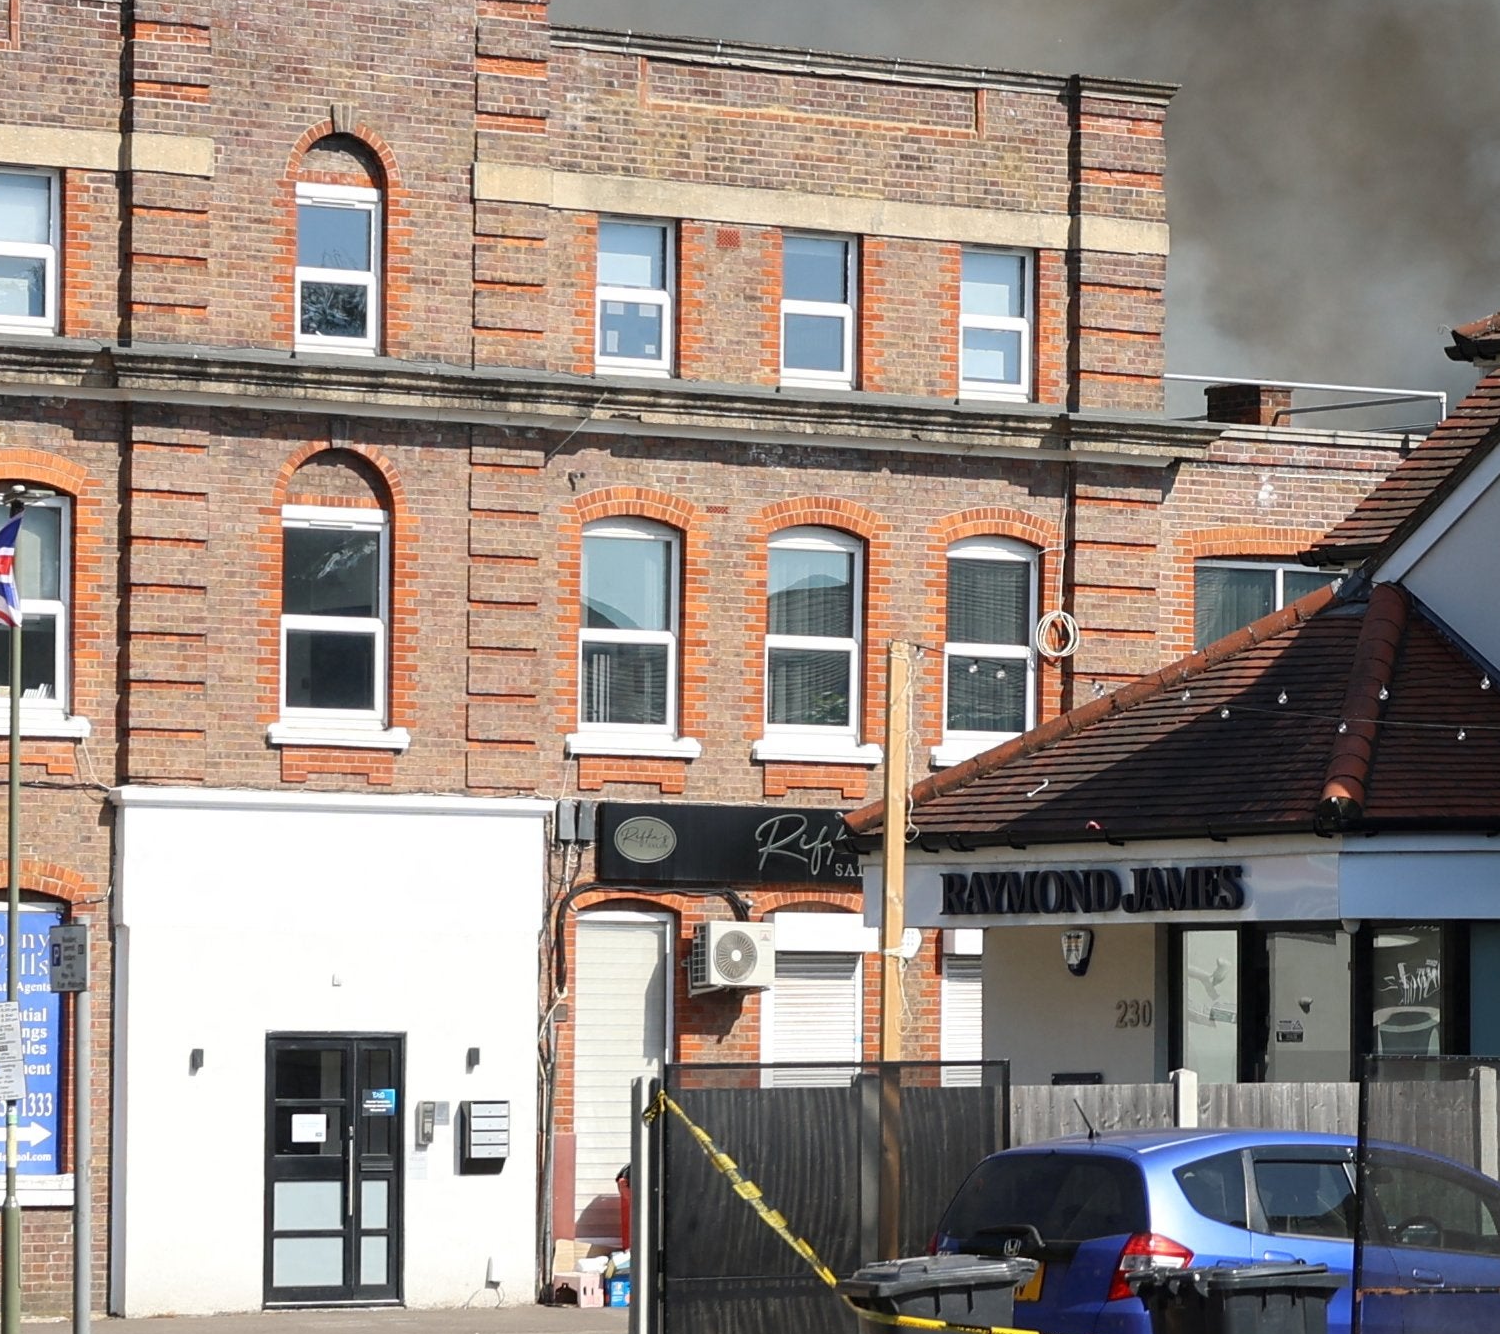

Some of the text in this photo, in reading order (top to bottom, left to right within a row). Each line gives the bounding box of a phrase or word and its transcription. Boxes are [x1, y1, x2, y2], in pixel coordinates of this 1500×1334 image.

[940, 865, 1245, 915] RAYMOND JAMES
[16, 981, 52, 994] Agents
[1115, 1000, 1153, 1029] 230
[21, 1093, 52, 1117] 1333
